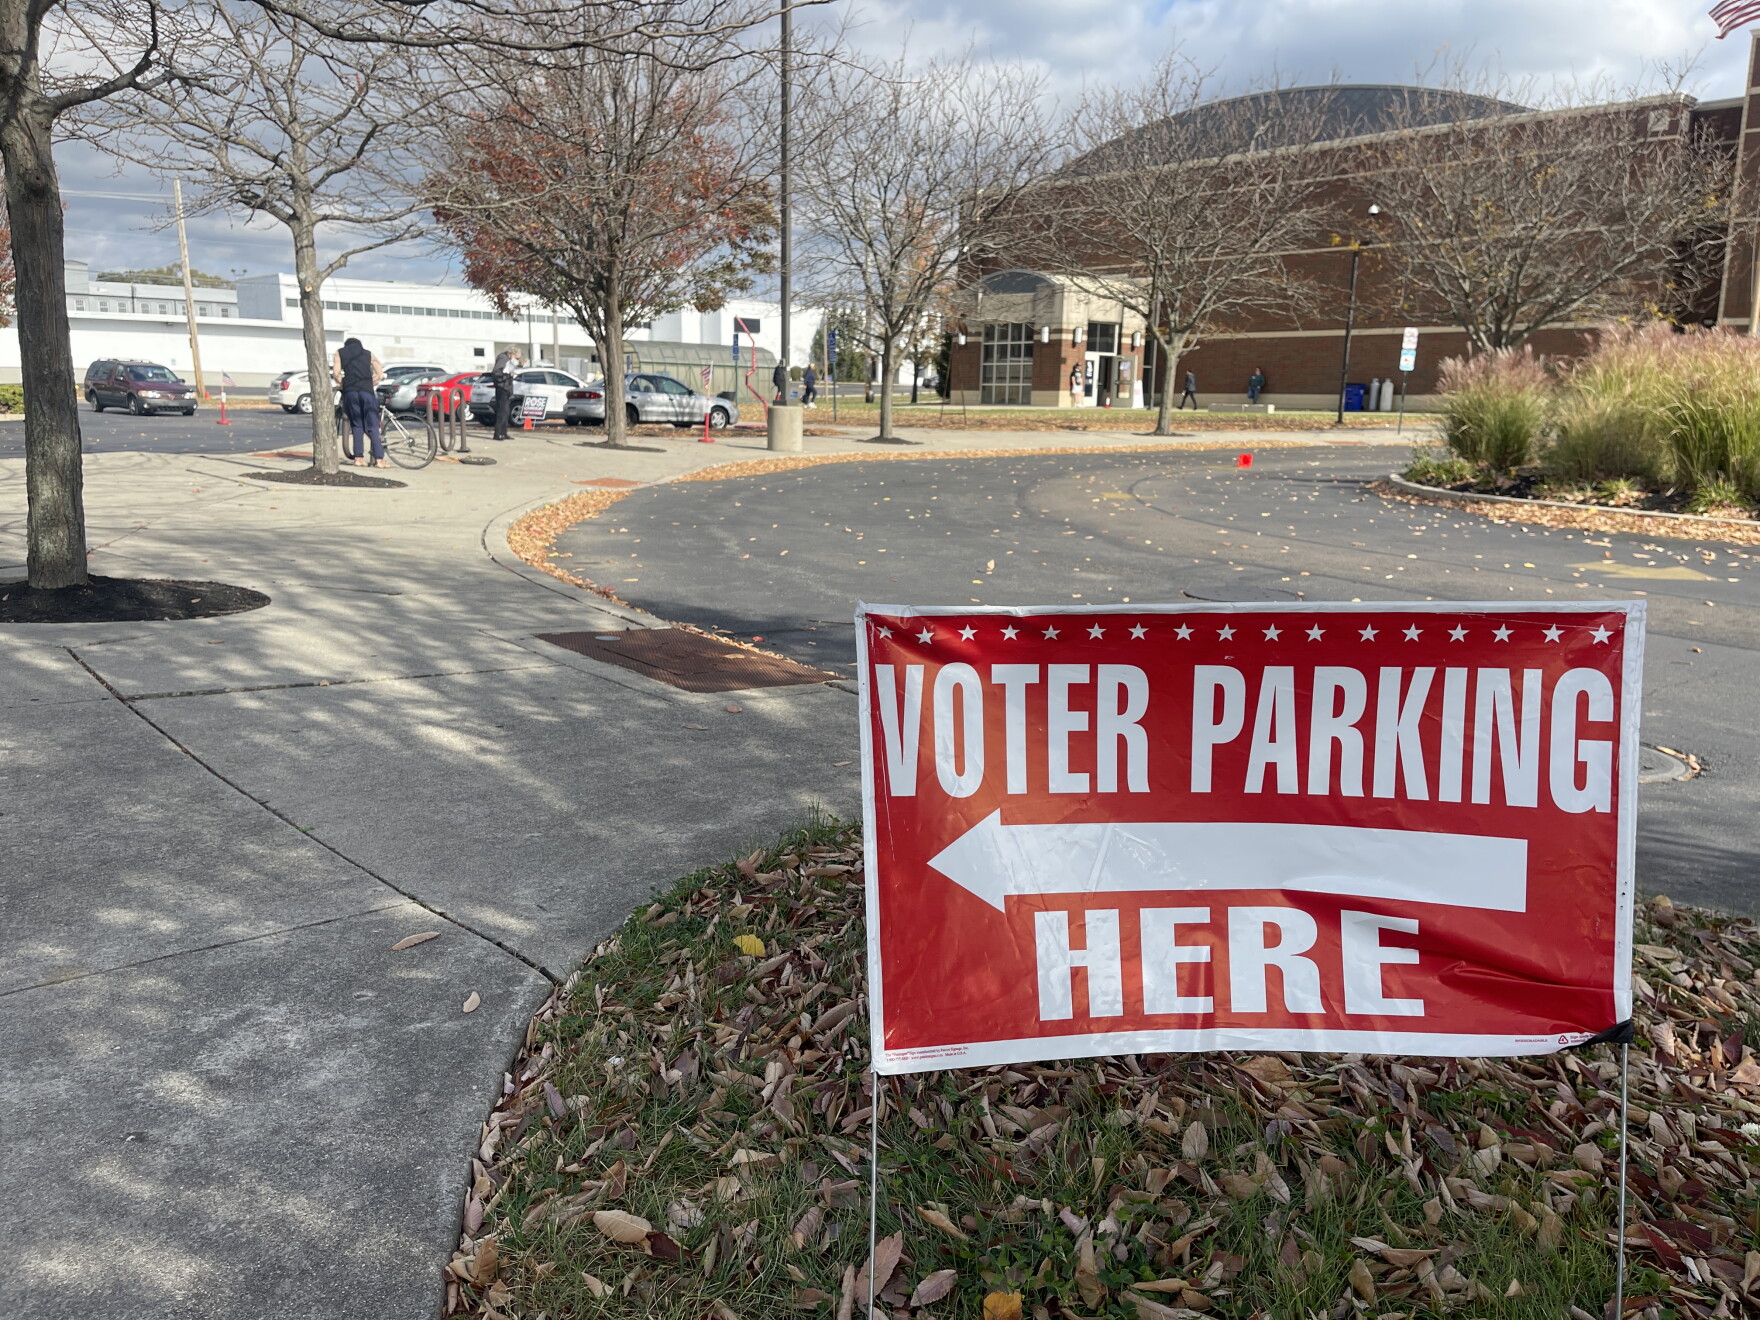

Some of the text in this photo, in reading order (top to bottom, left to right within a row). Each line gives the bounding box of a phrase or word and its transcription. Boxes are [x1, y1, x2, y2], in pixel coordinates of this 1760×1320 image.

[525, 397, 546, 407] ROSE
[875, 663, 1614, 814] VOTER PARKING
[1034, 906, 1426, 1022] HERE
